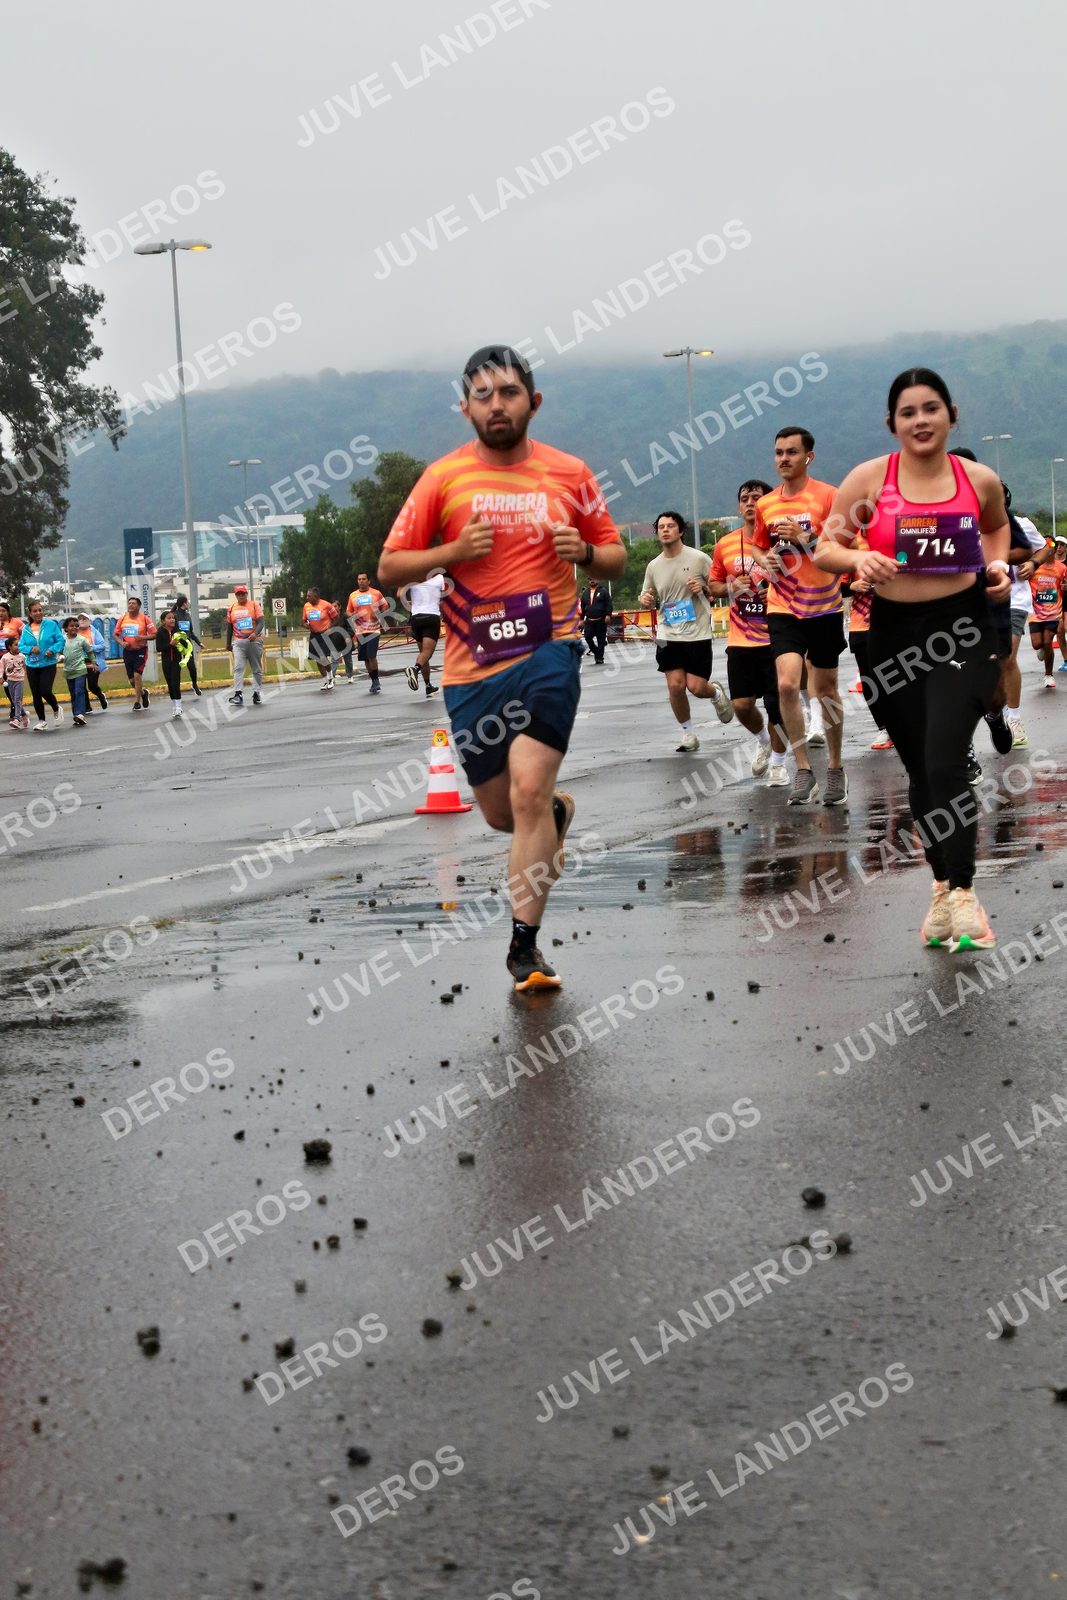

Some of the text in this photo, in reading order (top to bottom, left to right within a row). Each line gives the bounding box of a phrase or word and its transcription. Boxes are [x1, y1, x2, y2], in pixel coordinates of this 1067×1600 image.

[472, 492, 548, 512] CARRERA
[900, 518, 938, 528] CARRERA
[916, 538, 956, 556] 714
[130, 548, 146, 568] E
[669, 608, 688, 618] 2033
[745, 603, 764, 612] 423
[489, 618, 528, 641] 685
